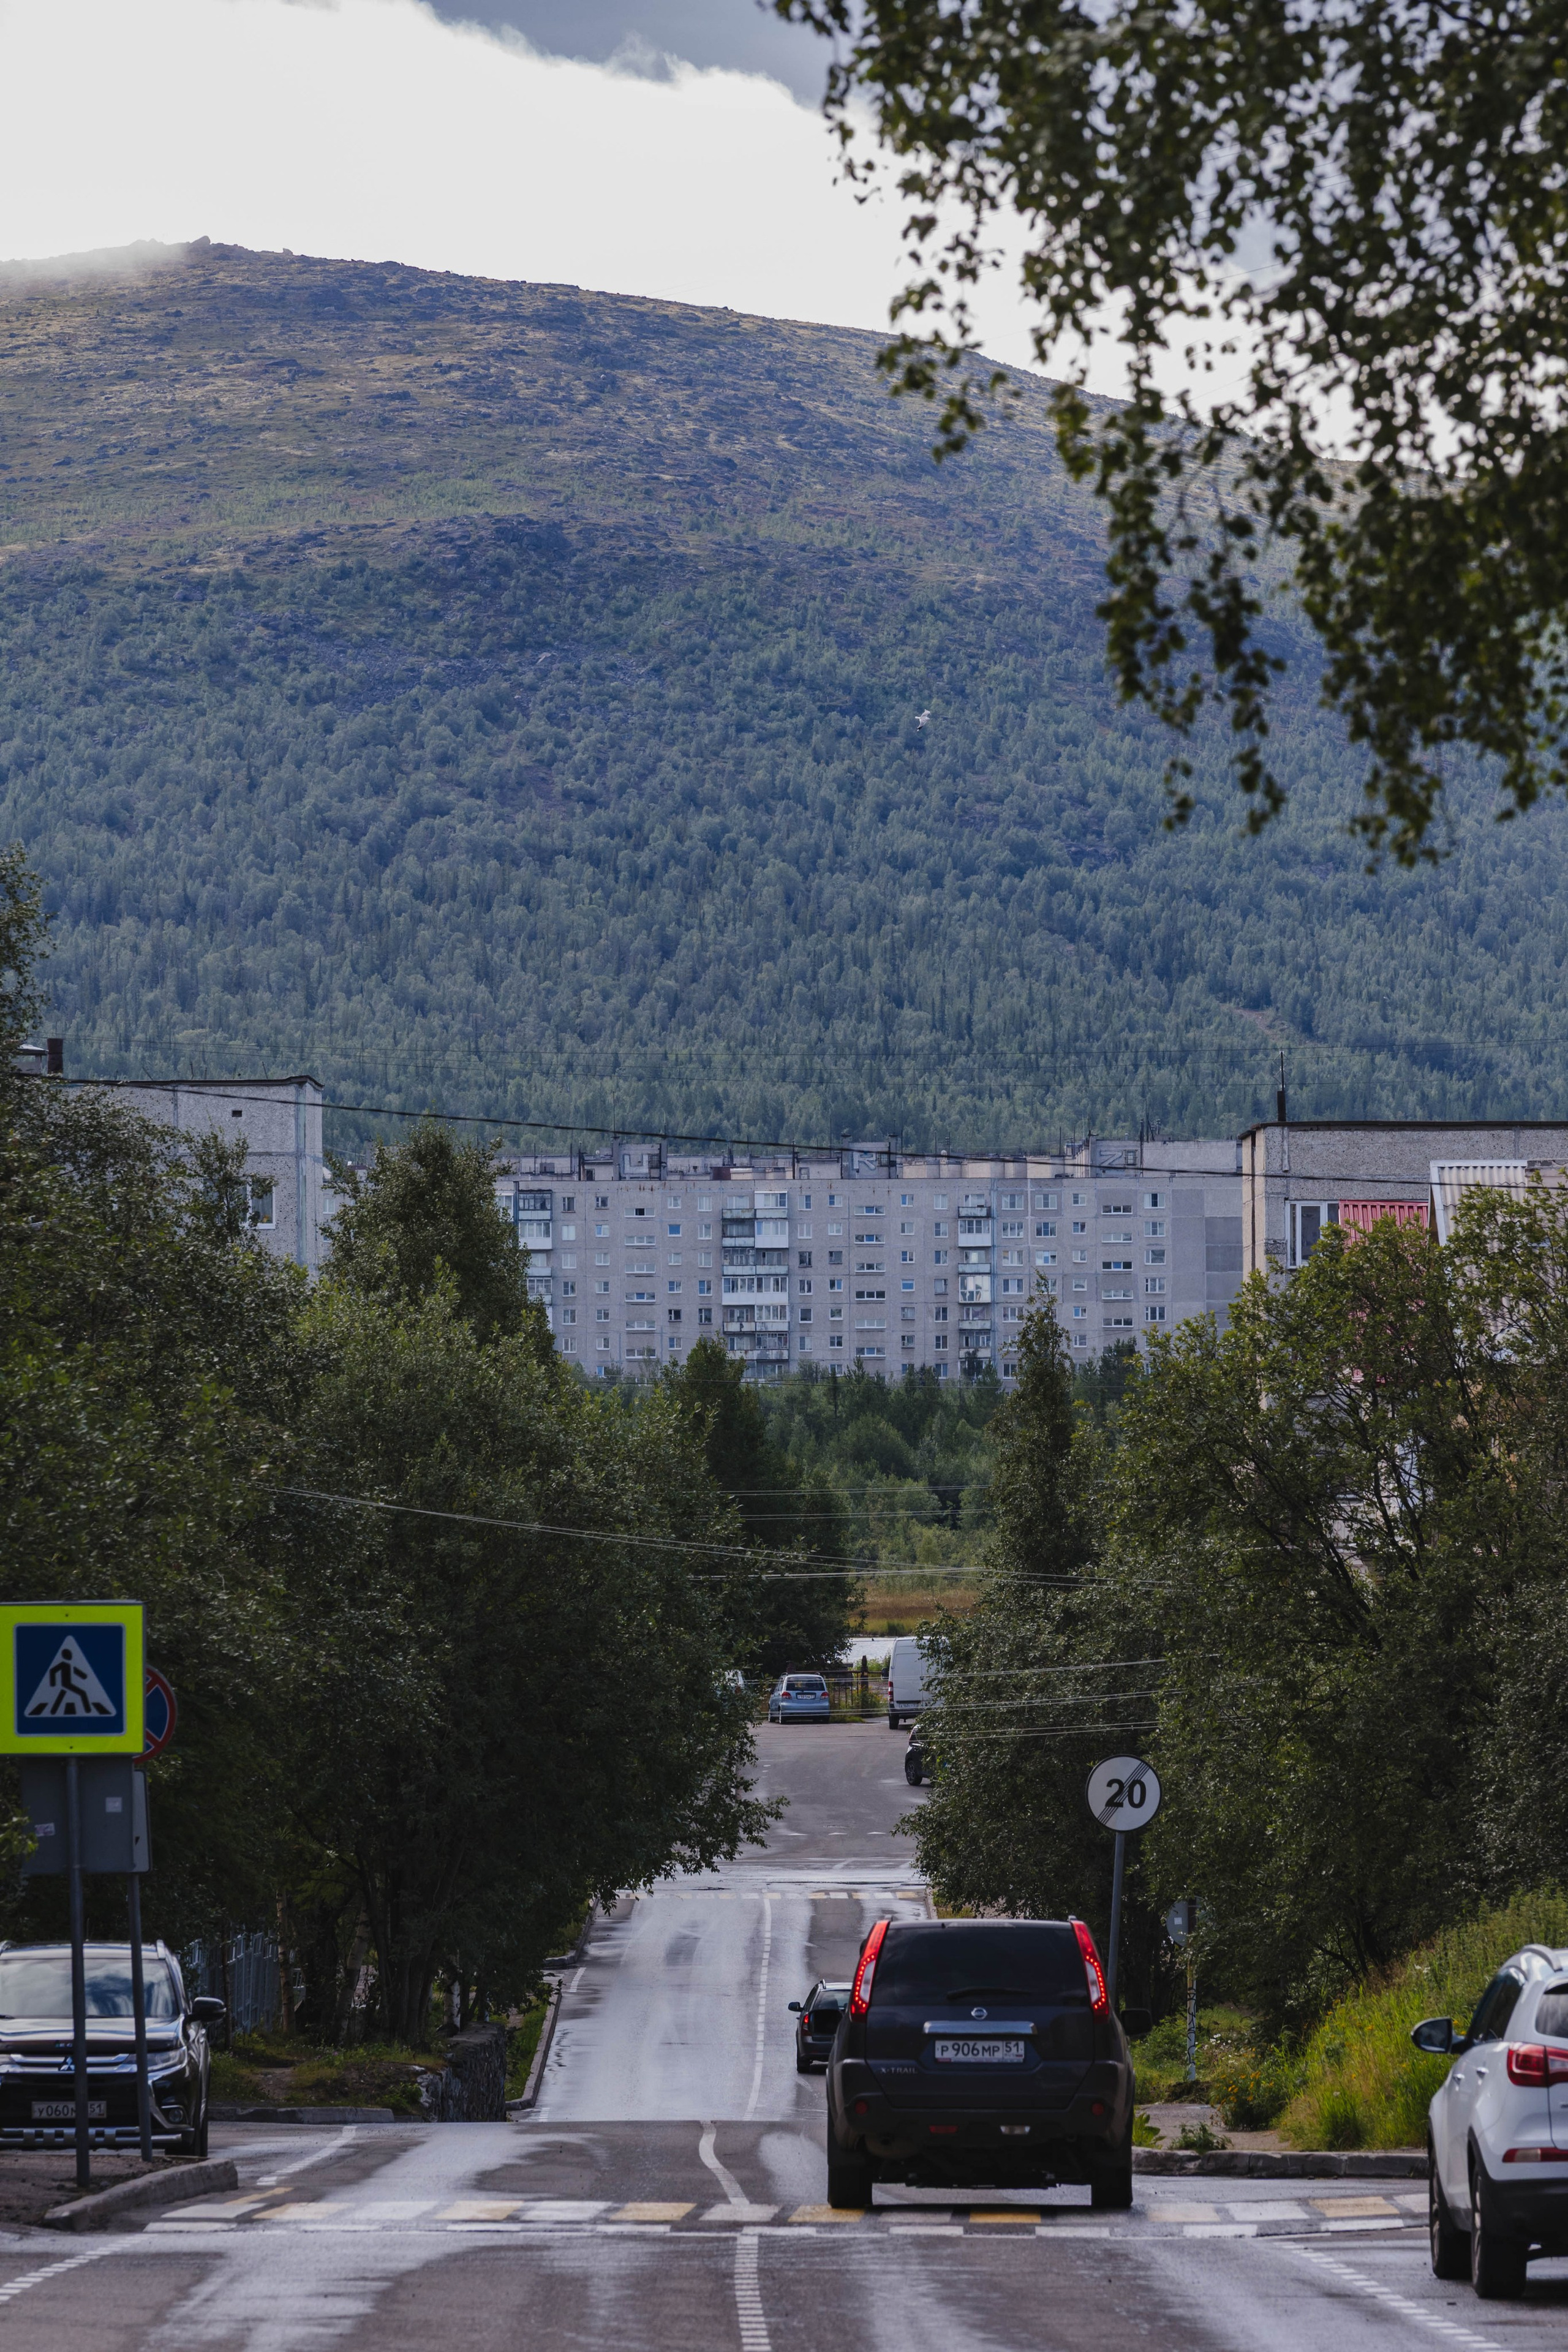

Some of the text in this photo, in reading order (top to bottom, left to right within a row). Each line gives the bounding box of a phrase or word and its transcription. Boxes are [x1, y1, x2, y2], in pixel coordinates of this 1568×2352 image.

[1104, 1778, 1147, 1809] 20
[1005, 2041, 1020, 2053] 51
[89, 2104, 102, 2114] 51
